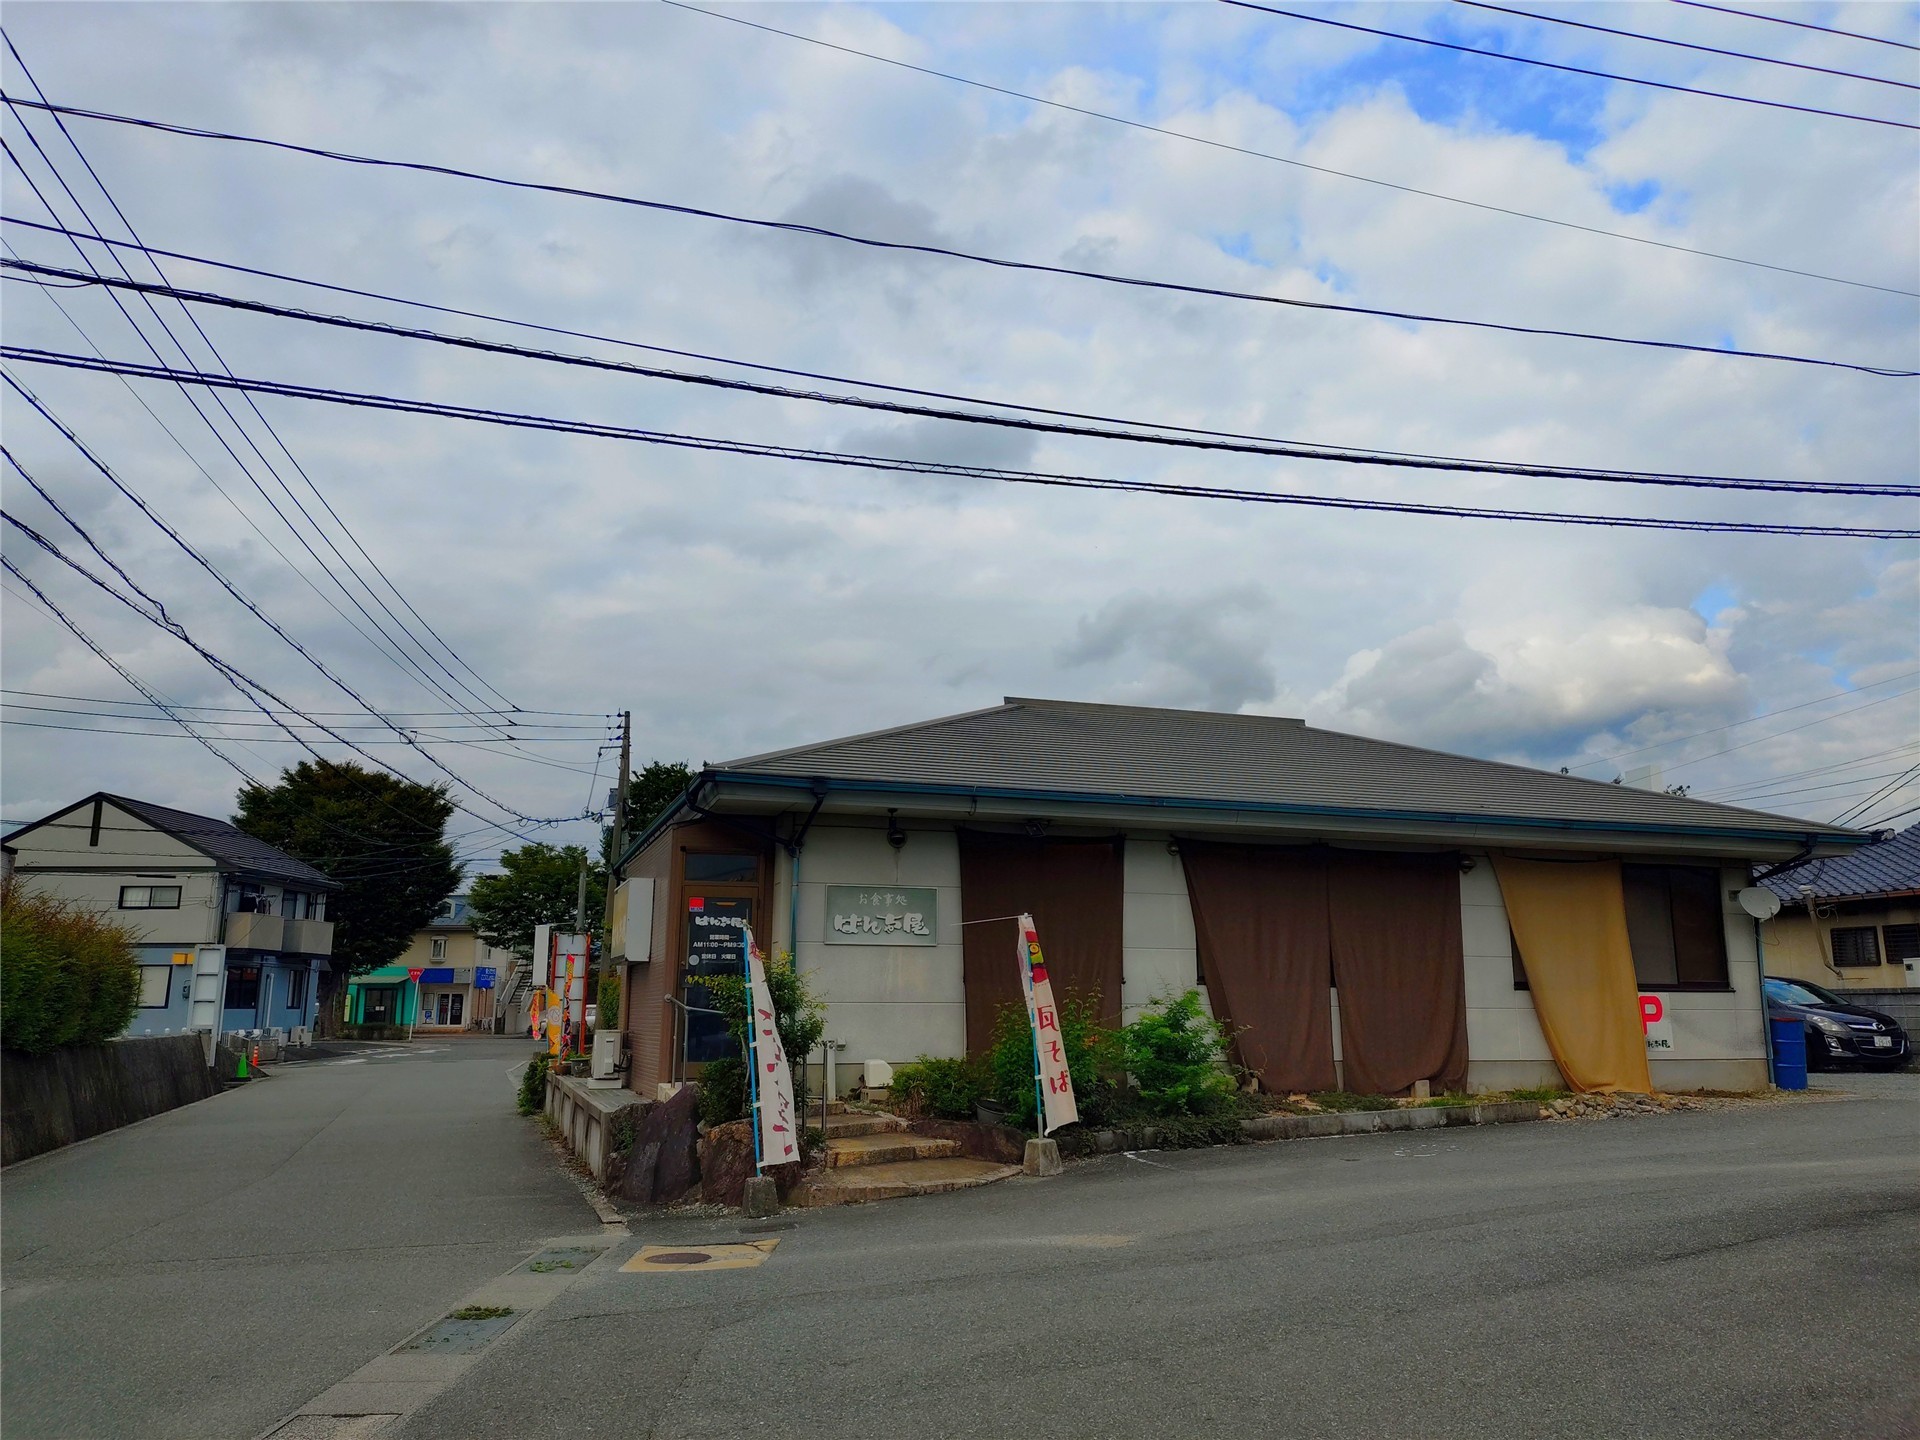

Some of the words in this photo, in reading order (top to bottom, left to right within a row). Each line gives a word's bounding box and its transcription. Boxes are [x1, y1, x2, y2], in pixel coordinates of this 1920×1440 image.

[859, 892, 908, 907] お食事処
[1638, 995, 1663, 1036] P
[1037, 1005, 1069, 1095] 瓦そば
